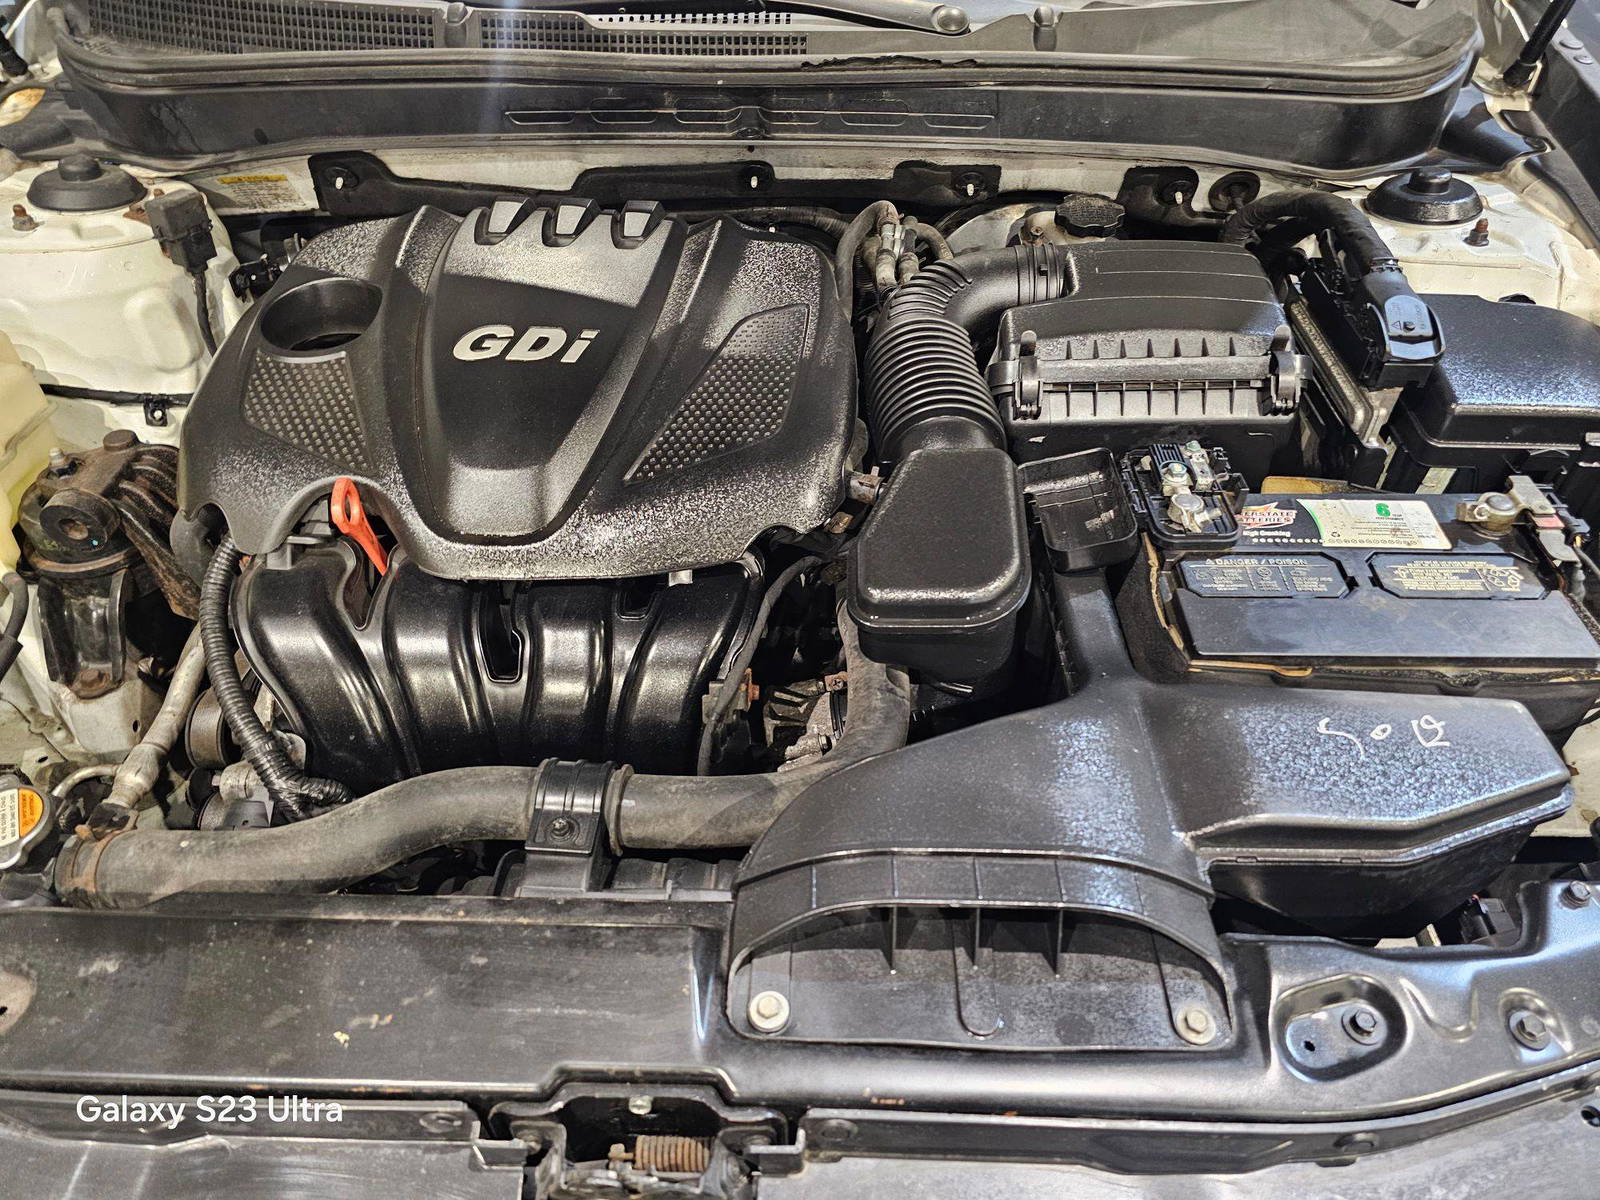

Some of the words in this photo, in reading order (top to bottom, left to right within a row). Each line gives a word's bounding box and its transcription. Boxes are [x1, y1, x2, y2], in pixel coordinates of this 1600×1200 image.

[453, 324, 601, 364] GDi
[1376, 503, 1390, 517] 6
[1216, 558, 1258, 566] DANGER
[1268, 558, 1308, 566] POISON
